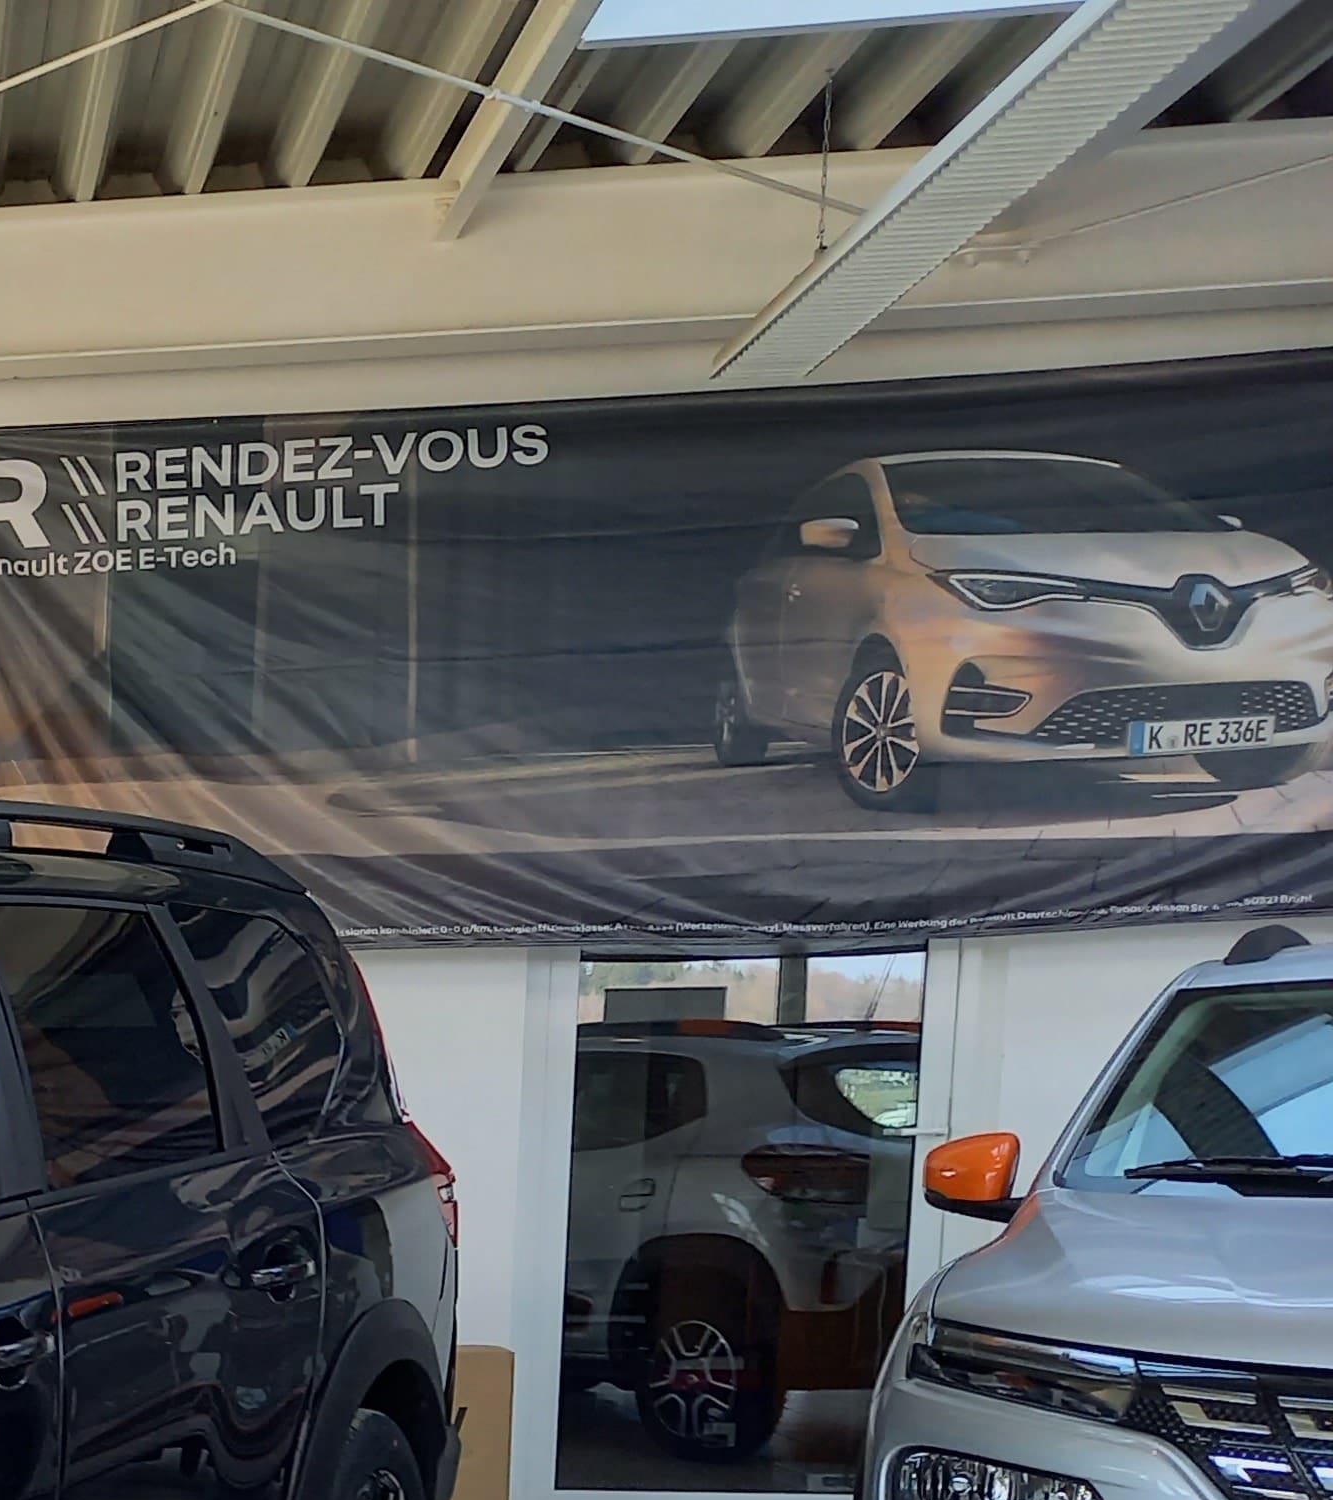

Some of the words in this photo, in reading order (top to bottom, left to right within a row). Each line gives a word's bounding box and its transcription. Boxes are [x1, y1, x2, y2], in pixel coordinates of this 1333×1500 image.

[115, 424, 549, 493] RENDEZ-VOUS
[116, 483, 400, 543] RENAULT
[73, 549, 132, 575] ZOE
[139, 542, 237, 570] E-Tech
[1148, 725, 1164, 750] K
[1184, 722, 1212, 747] RE
[1217, 719, 1268, 745] 336E
